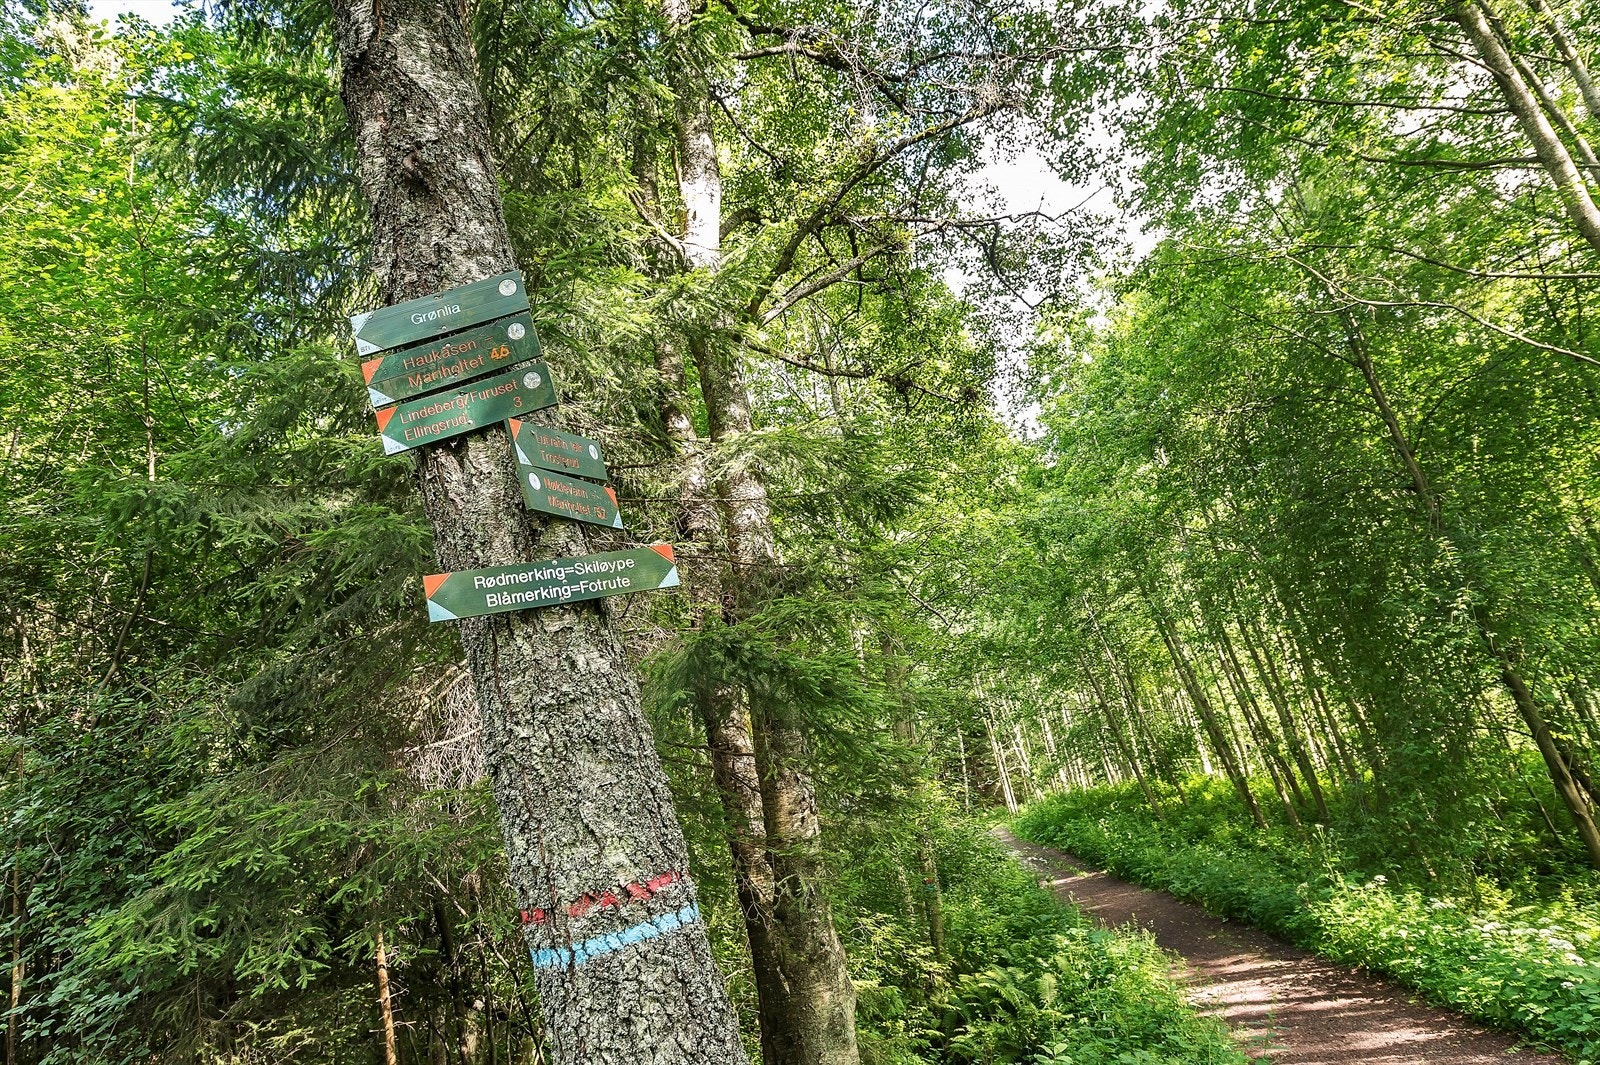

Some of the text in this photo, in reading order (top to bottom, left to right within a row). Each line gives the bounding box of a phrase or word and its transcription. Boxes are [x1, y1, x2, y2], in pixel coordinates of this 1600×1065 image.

[410, 303, 461, 325] Grønlia
[403, 338, 477, 370] Haukåsen
[408, 355, 485, 388] Mariholtet
[399, 379, 519, 425] Lindeberg/Furuset
[403, 396, 523, 442] Ellingsrud 3
[473, 557, 636, 590] Rødmerking=Skiløype
[485, 575, 631, 608] Blåmerking=Fotrute
